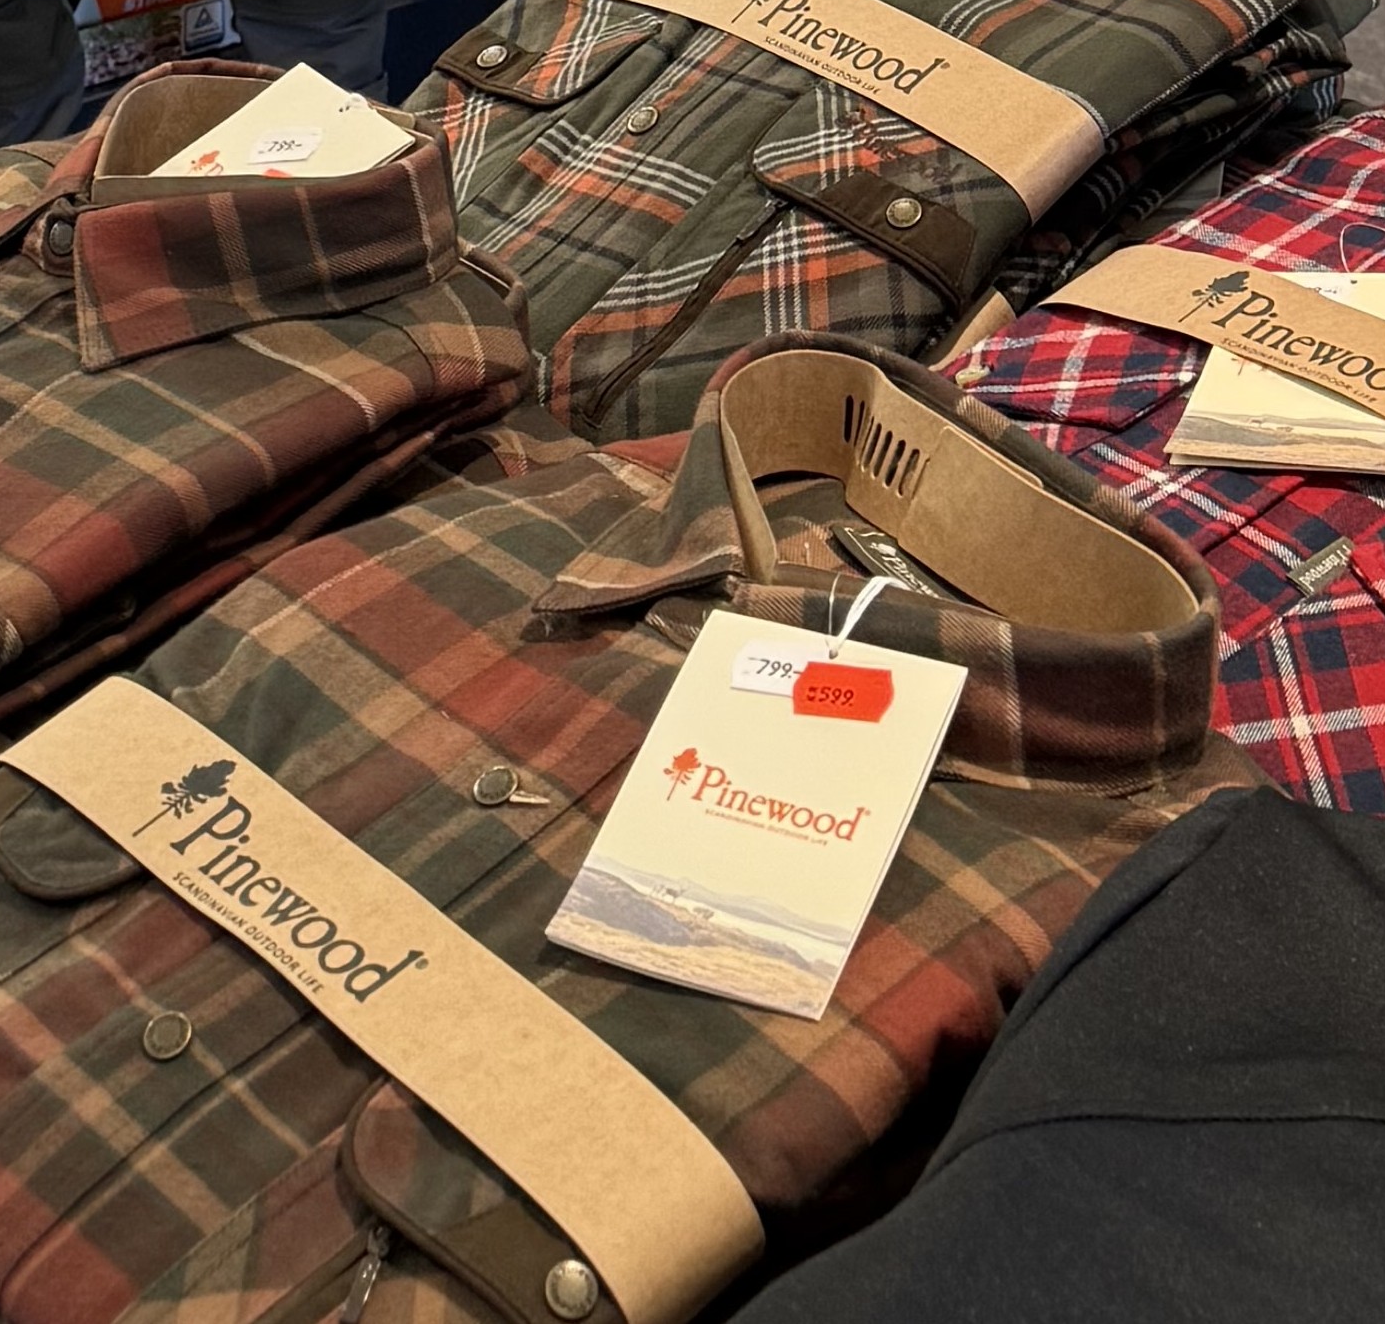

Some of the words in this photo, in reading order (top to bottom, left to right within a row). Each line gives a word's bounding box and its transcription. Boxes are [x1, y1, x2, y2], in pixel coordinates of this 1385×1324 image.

[691, 763, 866, 842] Pinewood
[170, 795, 420, 1003] Pinewood
[173, 870, 245, 928] SCANDINAVIAN
[244, 921, 300, 975] OUTDOOR
[296, 963, 325, 995] LIFE
